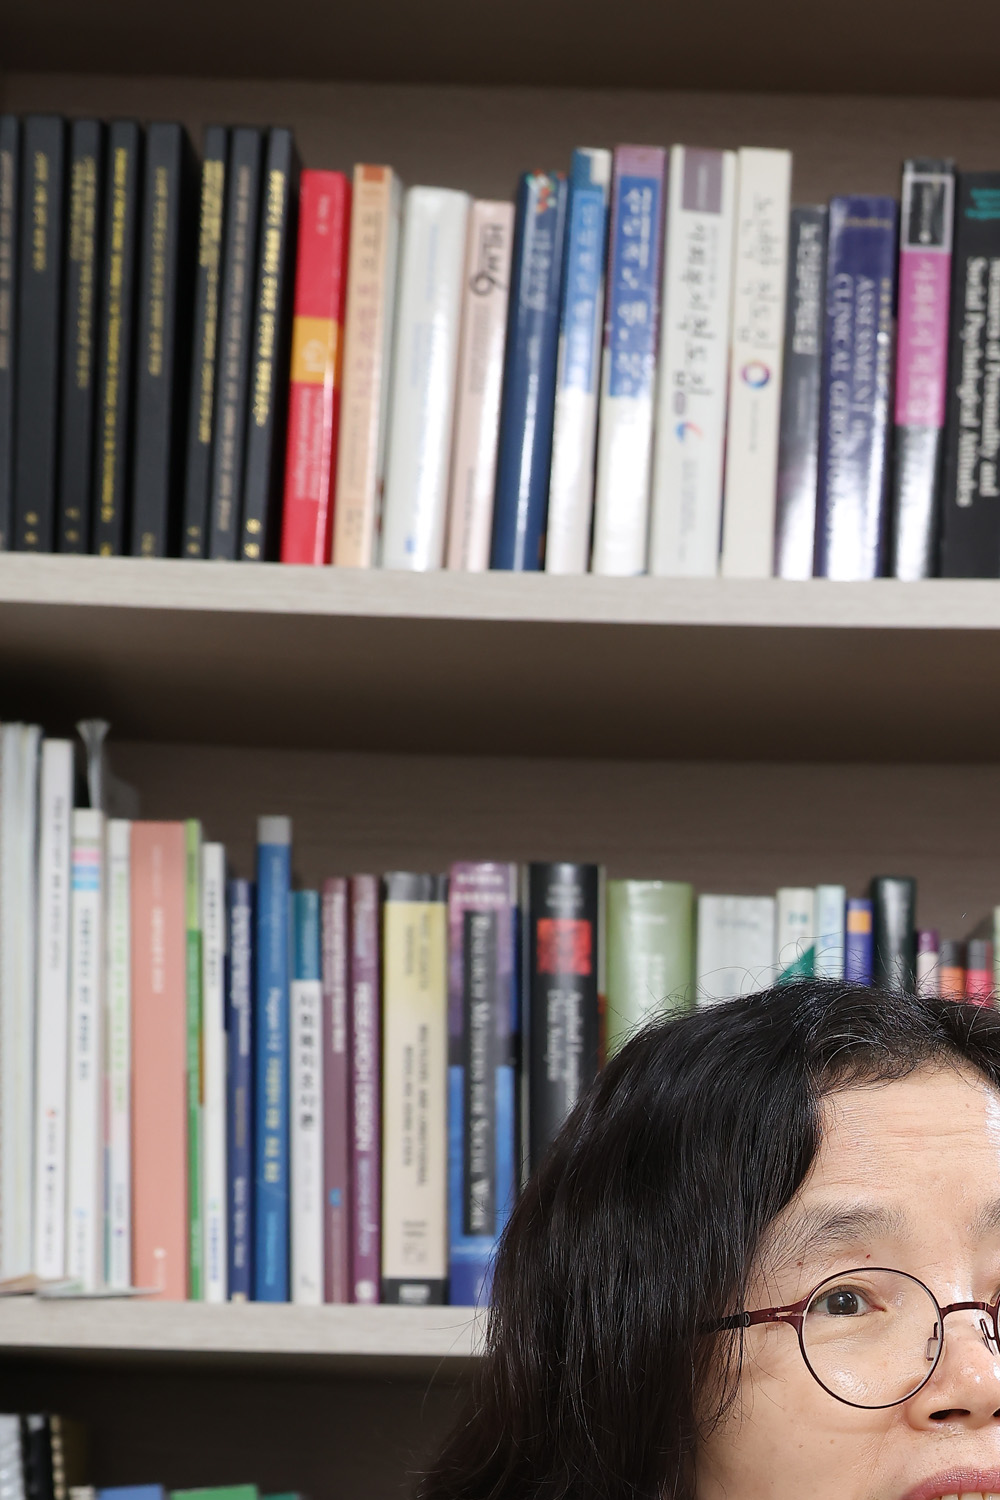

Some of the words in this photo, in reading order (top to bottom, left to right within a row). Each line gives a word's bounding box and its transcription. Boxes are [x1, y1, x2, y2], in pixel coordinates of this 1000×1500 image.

[963, 256, 988, 311] Social
[828, 272, 853, 377] CLINICAL
[853, 274, 876, 413] ASSESSMENT
[956, 312, 985, 428] Psychological
[954, 429, 979, 508] Attitudes
[979, 461, 1000, 498] and
[470, 915, 491, 998] RESEARCH
[546, 989, 563, 1025] Data
[562, 989, 583, 1042] Applied
[470, 1000, 490, 1081] METHODS
[471, 1084, 488, 1115] FOR
[469, 1118, 490, 1173] SOCIAL
[469, 1177, 489, 1231] WORK
